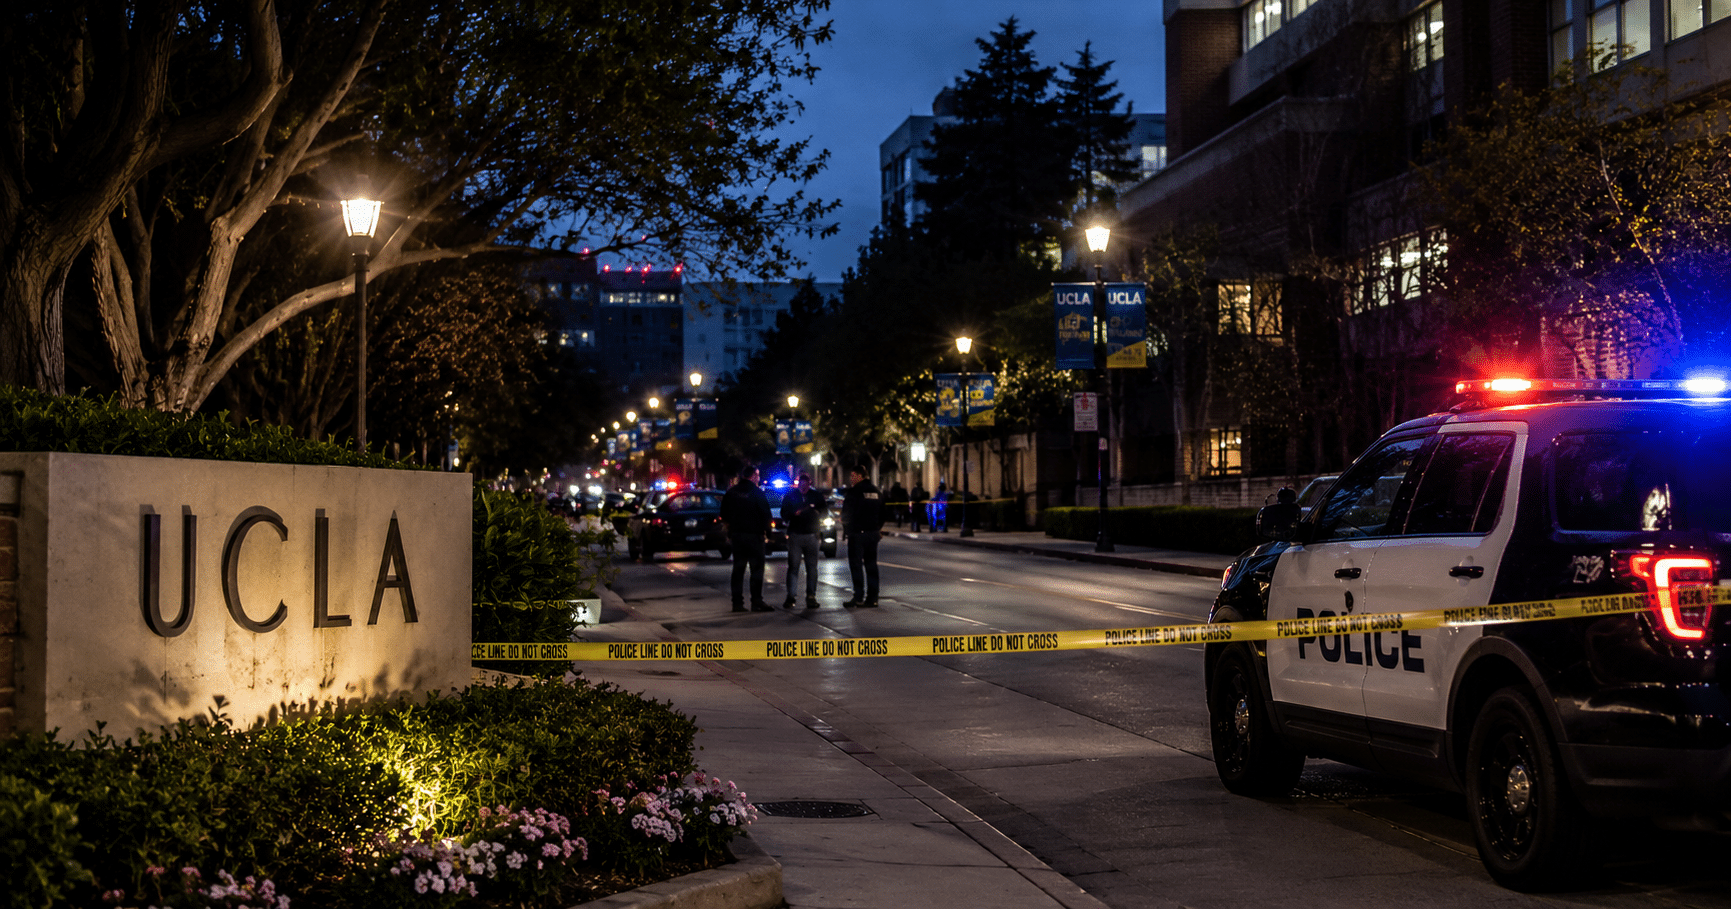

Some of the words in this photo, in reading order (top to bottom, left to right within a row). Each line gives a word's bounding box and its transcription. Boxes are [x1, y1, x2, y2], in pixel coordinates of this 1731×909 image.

[1057, 292, 1091, 305] UCLA
[1108, 291, 1142, 305] UCLA
[140, 505, 419, 637] UCLA
[1105, 629, 1137, 646] POLICE
[1163, 627, 1175, 643] DO
[1179, 626, 1197, 642] NOT
[1277, 620, 1310, 637] POLICE
[766, 641, 798, 657] POLICE
[800, 641, 819, 656] LINE
[822, 640, 834, 656] DO
[837, 640, 855, 656] NOT
[858, 639, 888, 655] CROSS
[932, 636, 964, 653] POLICE
[967, 636, 988, 652] LINE
[991, 635, 1003, 650] DO
[1006, 634, 1024, 650] NOT
[1027, 633, 1058, 649] CROSS
[1297, 607, 1425, 673] POLICE
[488, 644, 506, 658] LINE
[508, 644, 519, 658] DO
[522, 644, 539, 658] NOT
[541, 644, 568, 658] CROSS
[608, 643, 637, 659] POLICE
[640, 643, 659, 659] LINE
[661, 643, 673, 659] DO
[675, 643, 692, 658] NOT
[695, 643, 724, 658] CROSS
